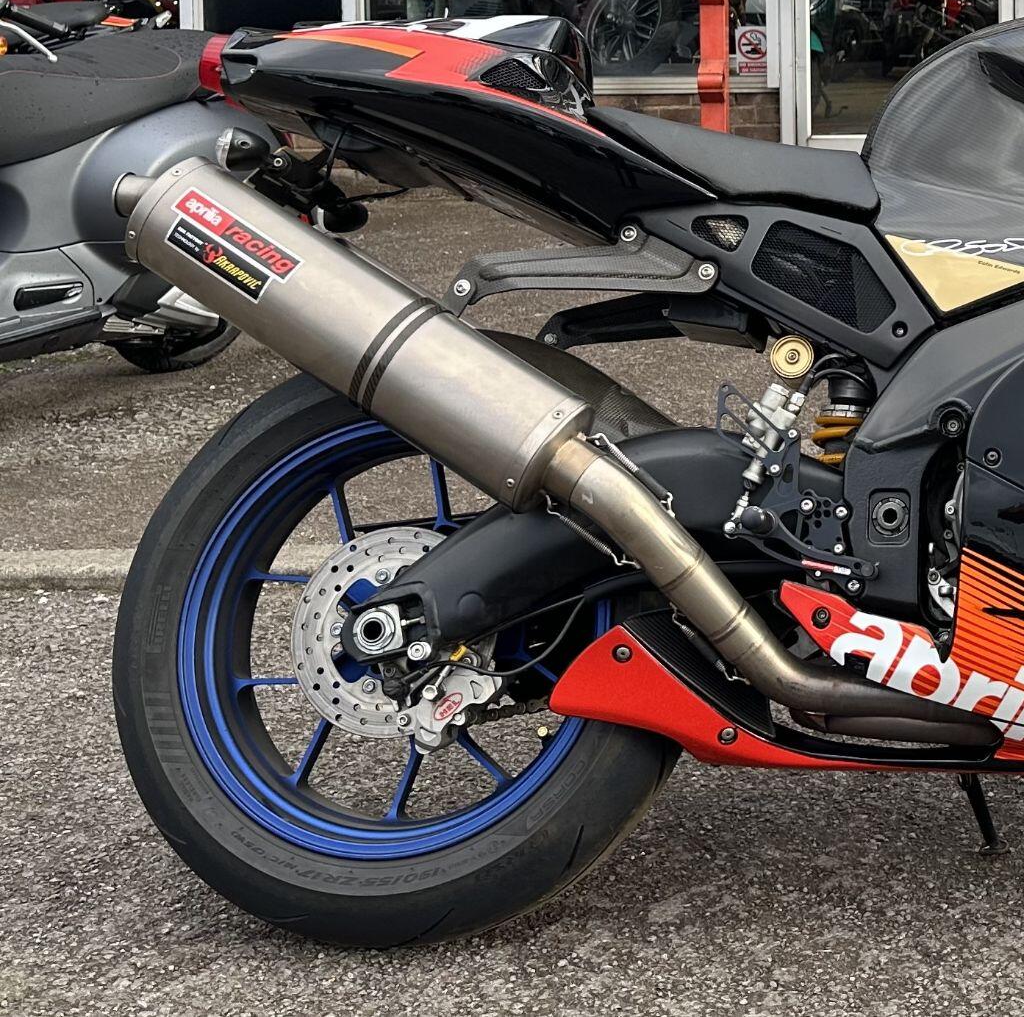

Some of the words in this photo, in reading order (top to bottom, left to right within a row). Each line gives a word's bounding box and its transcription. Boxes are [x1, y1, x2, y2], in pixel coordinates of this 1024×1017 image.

[184, 196, 223, 227] aprilia
[225, 225, 296, 275] racing
[977, 260, 993, 268] Colin
[994, 263, 1021, 275] Edwards
